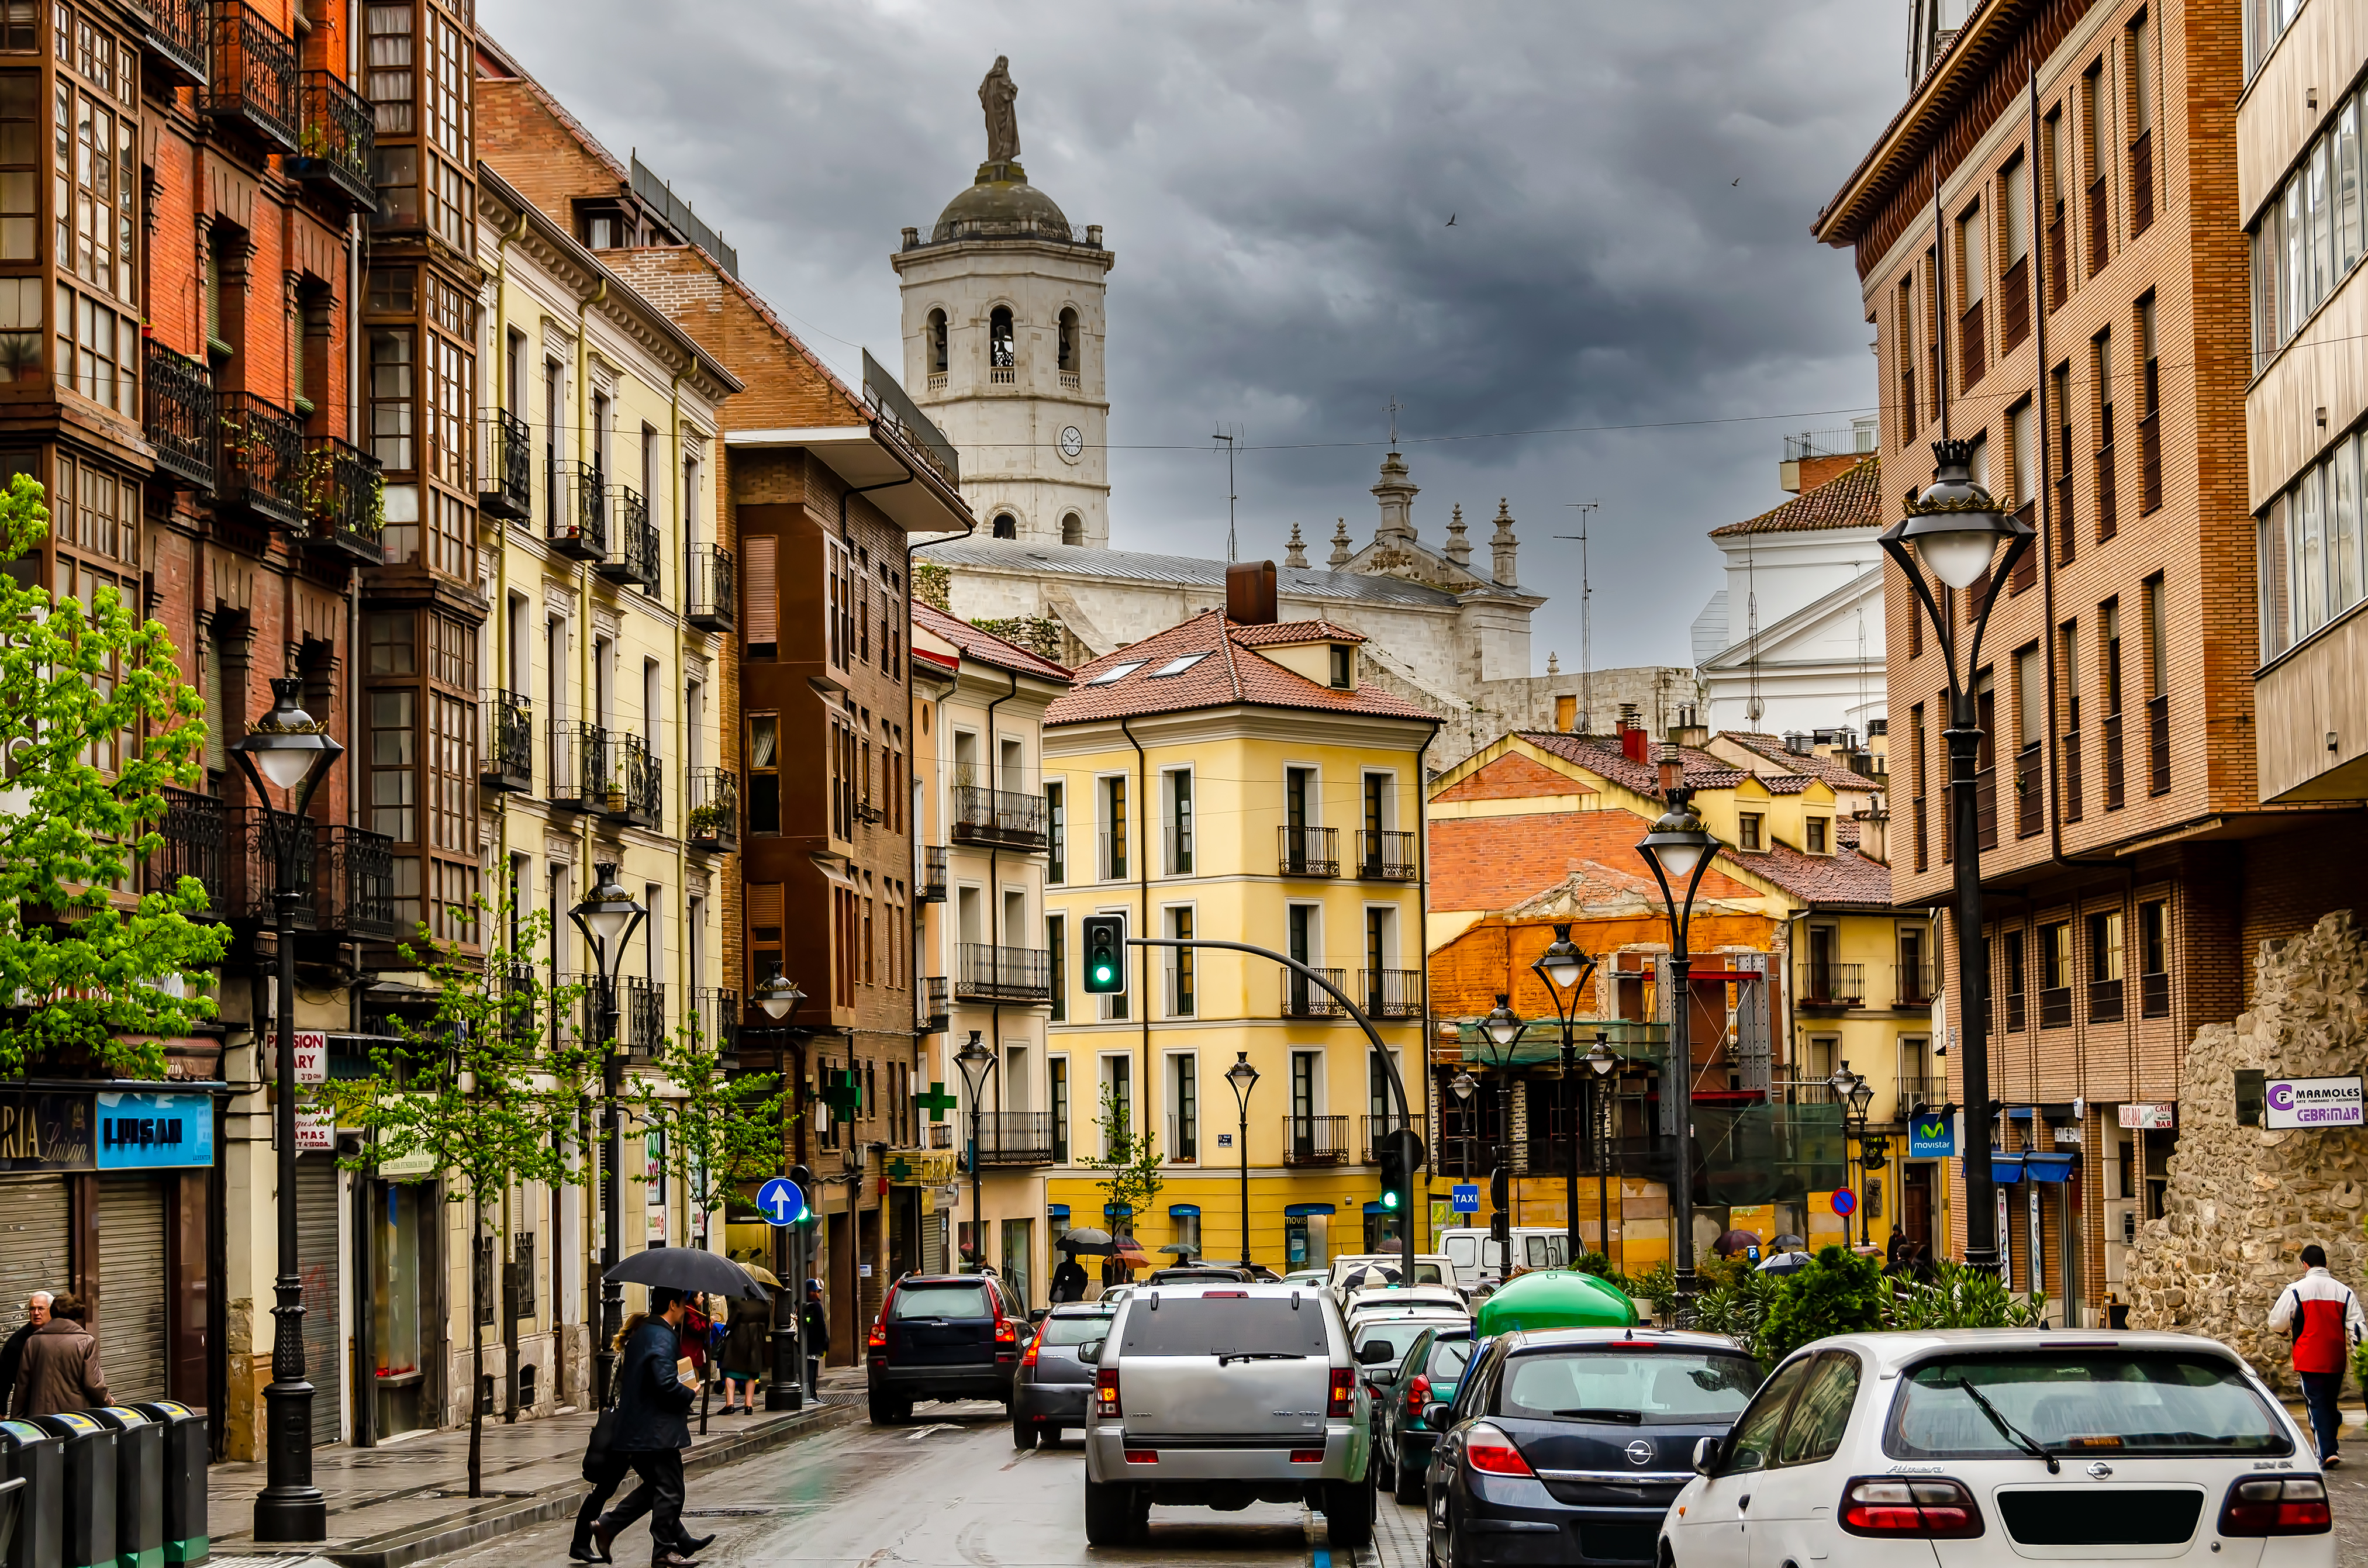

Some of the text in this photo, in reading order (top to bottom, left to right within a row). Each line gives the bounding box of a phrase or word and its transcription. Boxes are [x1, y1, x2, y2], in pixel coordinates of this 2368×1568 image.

[267, 1035, 323, 1048] PSION
[2295, 1087, 2360, 1099] MARMOLES
[103, 1117, 183, 1145] LUISAN
[295, 1131, 325, 1139] AMAS
[1454, 1194, 1478, 1203] TAXI
[1749, 1248, 1756, 1258] P
[1886, 1464, 1945, 1473] Almera
